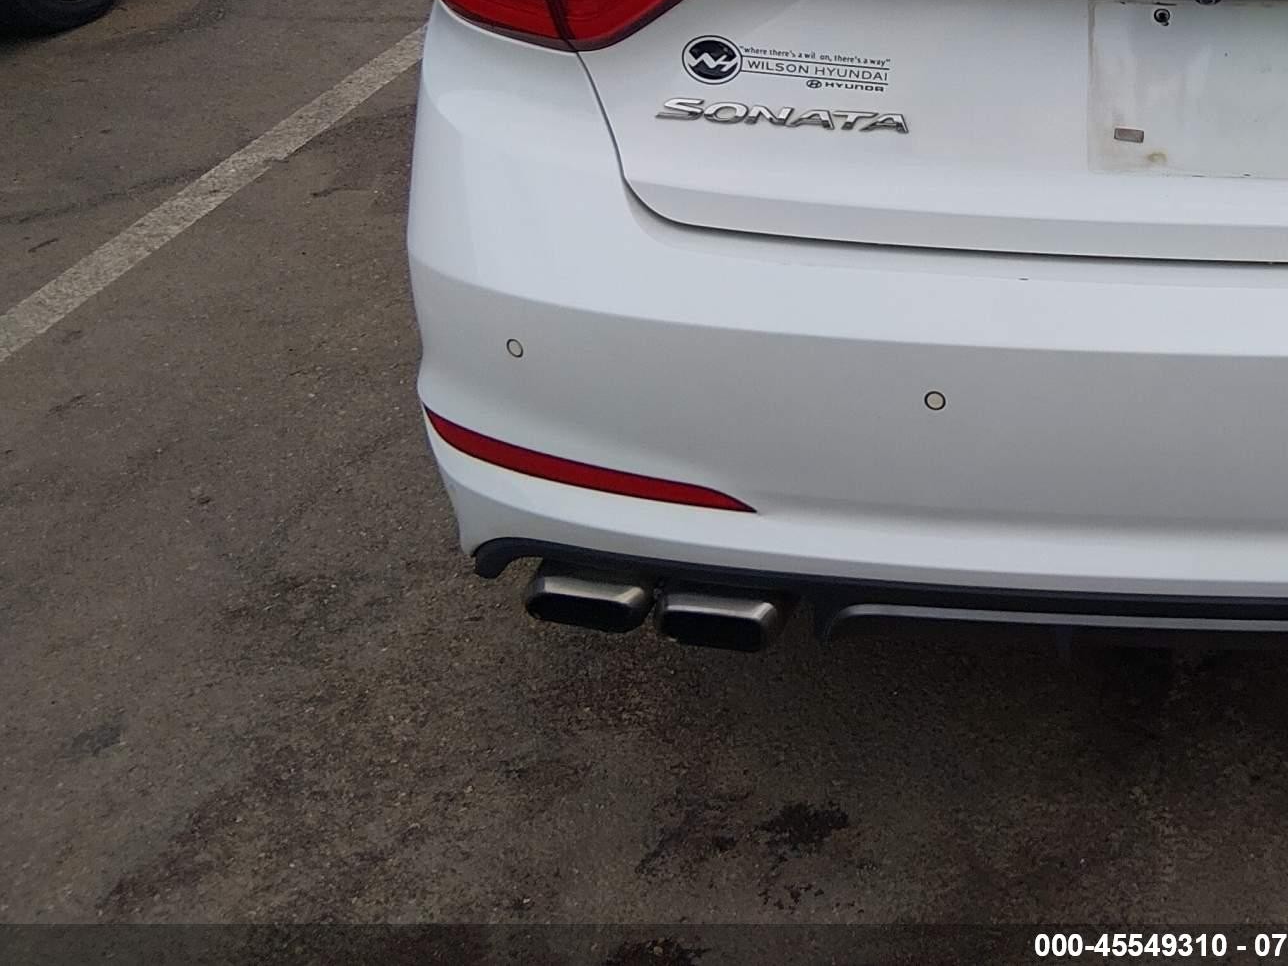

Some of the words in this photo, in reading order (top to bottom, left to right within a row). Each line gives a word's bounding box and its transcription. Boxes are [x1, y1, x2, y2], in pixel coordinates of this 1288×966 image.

[769, 49, 796, 58] there's
[834, 54, 861, 64] there's
[747, 60, 809, 74] WILSON
[814, 66, 889, 81] HYUNDAI
[655, 97, 909, 134] SONATA
